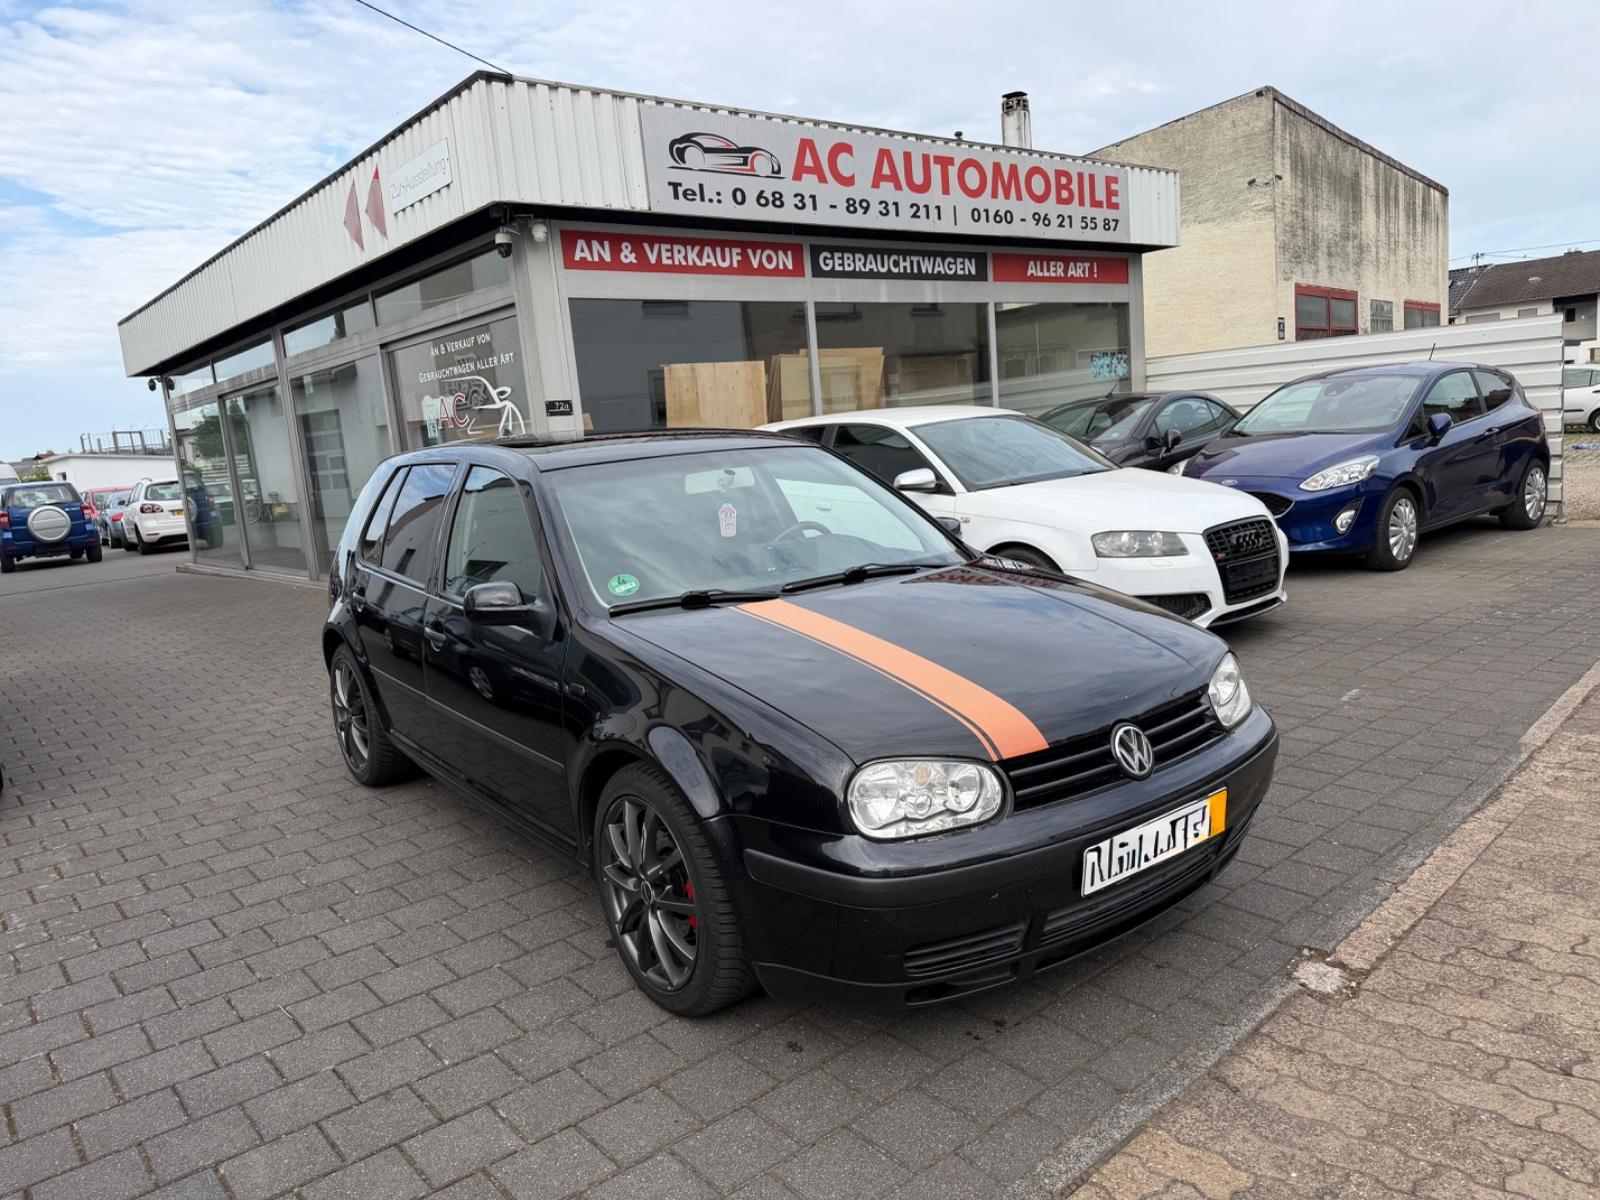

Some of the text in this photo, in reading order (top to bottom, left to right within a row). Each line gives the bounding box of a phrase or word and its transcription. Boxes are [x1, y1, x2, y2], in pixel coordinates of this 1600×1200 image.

[792, 137, 1120, 211] AC AUTOMOBILE
[667, 181, 723, 205] Tel.:
[731, 187, 747, 206] 0
[756, 189, 785, 209] 68
[793, 192, 818, 211] 31
[845, 197, 871, 215] 89
[878, 200, 900, 217] 31
[909, 203, 942, 221] 211
[971, 207, 1014, 225] 0160
[1032, 211, 1051, 227] 96
[1056, 214, 1073, 229] 21
[1080, 216, 1098, 230] 55
[1103, 217, 1120, 232] 87
[574, 239, 611, 263] AN
[620, 241, 638, 264] &
[643, 242, 742, 268] VERKAUF
[747, 249, 793, 270] VON
[818, 251, 977, 276] GEBRAUCHTWAGEN
[1027, 260, 1065, 278] ALLER
[1067, 262, 1090, 279] ART
[437, 392, 470, 430] AC
